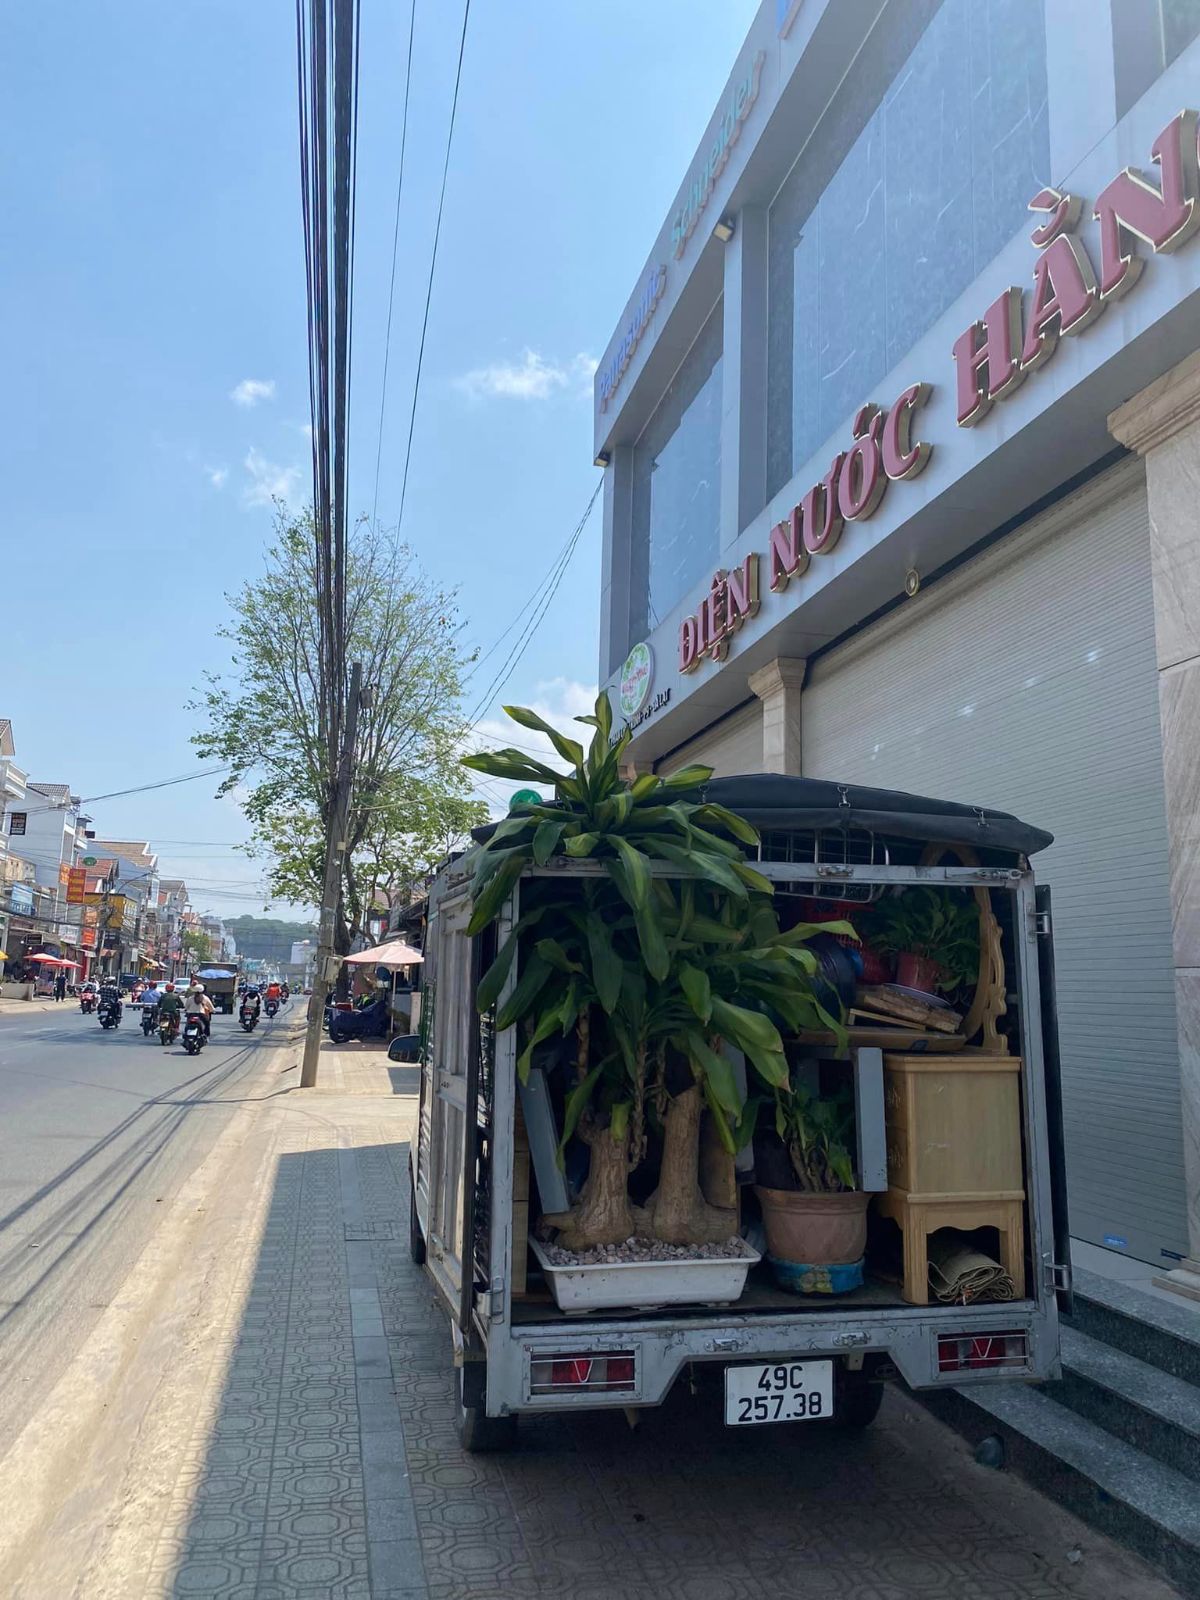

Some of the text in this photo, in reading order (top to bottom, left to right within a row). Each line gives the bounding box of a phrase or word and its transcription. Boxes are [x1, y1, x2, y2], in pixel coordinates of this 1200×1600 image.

[678, 108, 1200, 674] ĐIỆN NƯỚC HẰN
[758, 1365, 803, 1391] 49C
[738, 1391, 822, 1422] 257.38
